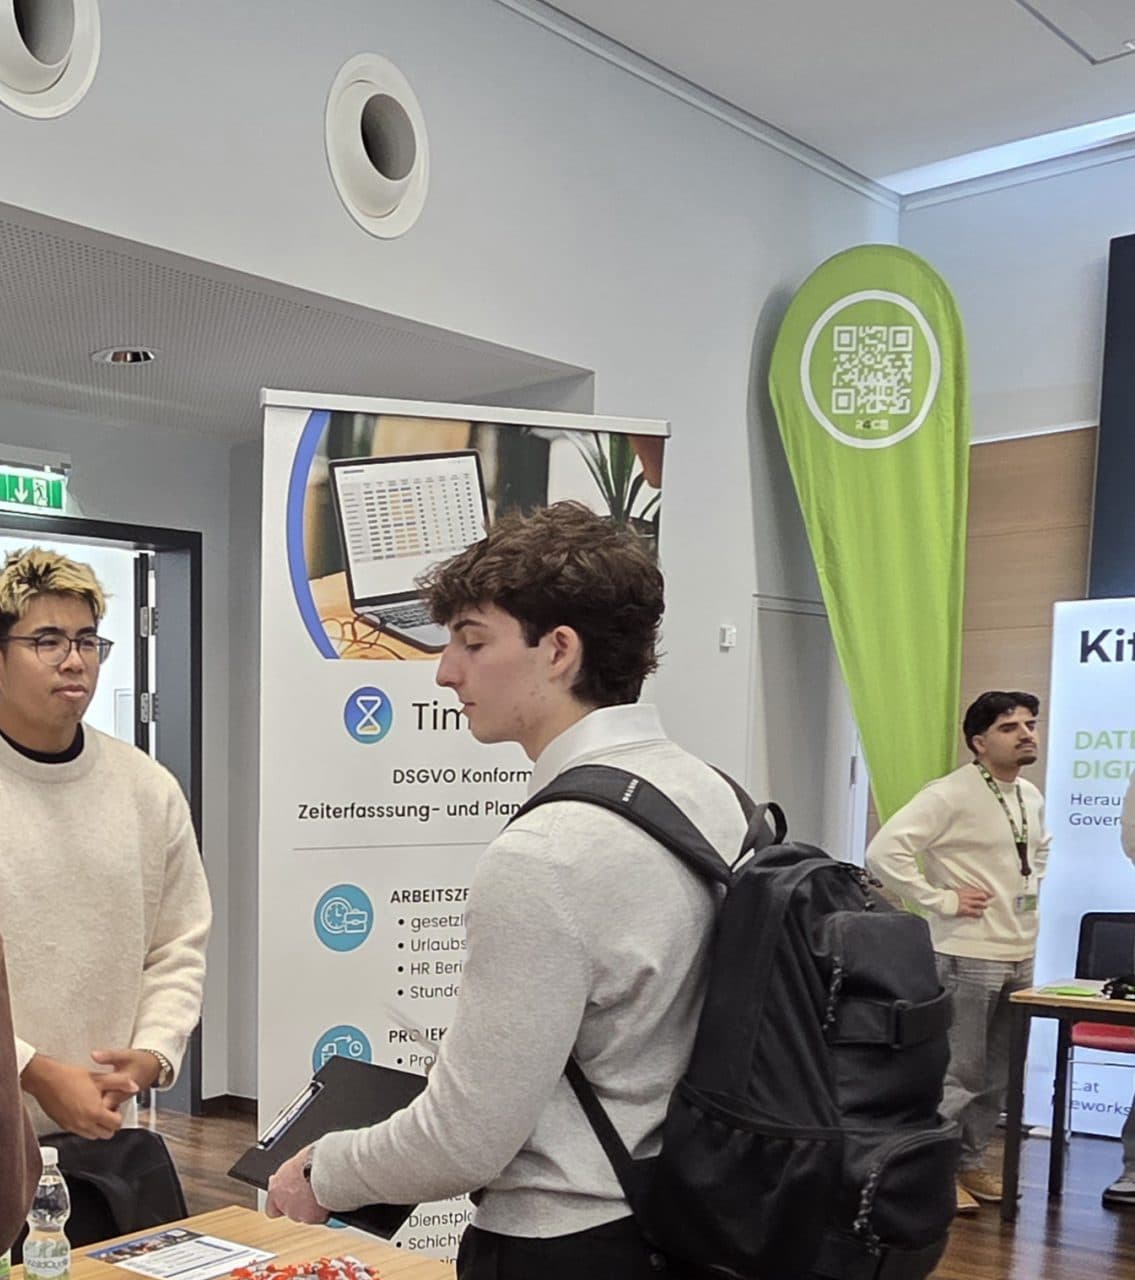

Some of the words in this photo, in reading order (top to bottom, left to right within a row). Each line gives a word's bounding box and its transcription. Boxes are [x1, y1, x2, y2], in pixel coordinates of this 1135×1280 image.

[393, 768, 456, 784] DSGVO
[462, 766, 532, 783] Konform
[298, 801, 440, 822] Zeiterfasssung-
[446, 800, 479, 816] und
[410, 962, 431, 975] HR
